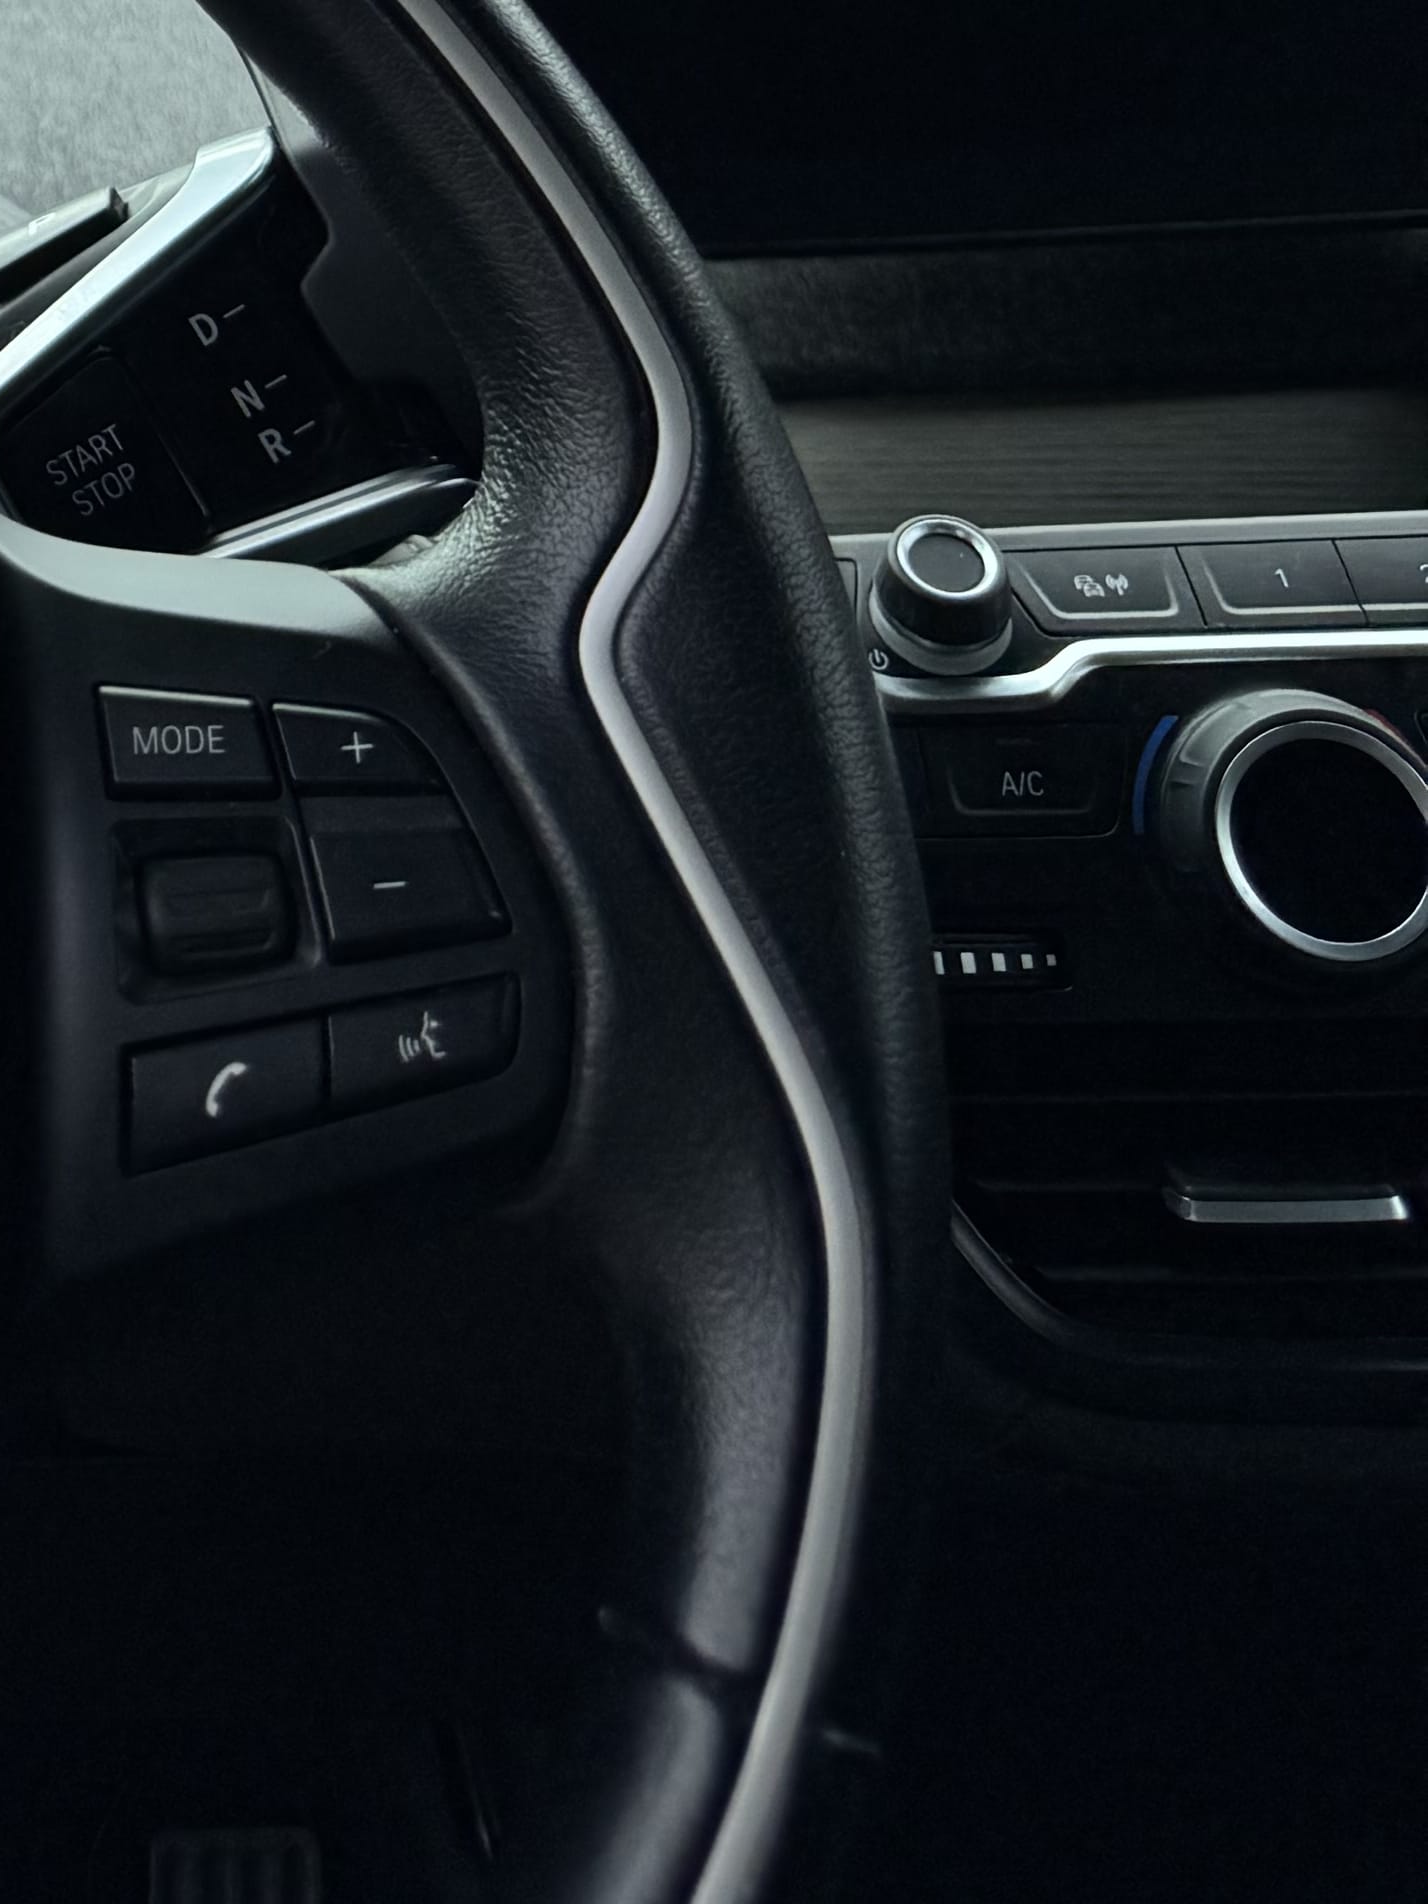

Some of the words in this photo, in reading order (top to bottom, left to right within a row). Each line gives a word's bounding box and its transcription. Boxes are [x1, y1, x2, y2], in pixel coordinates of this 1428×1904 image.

[46, 423, 124, 485] START
[72, 463, 135, 516] STOP
[1274, 567, 1290, 589] 1
[132, 724, 226, 755] MODE
[1001, 770, 1045, 797] A/C
